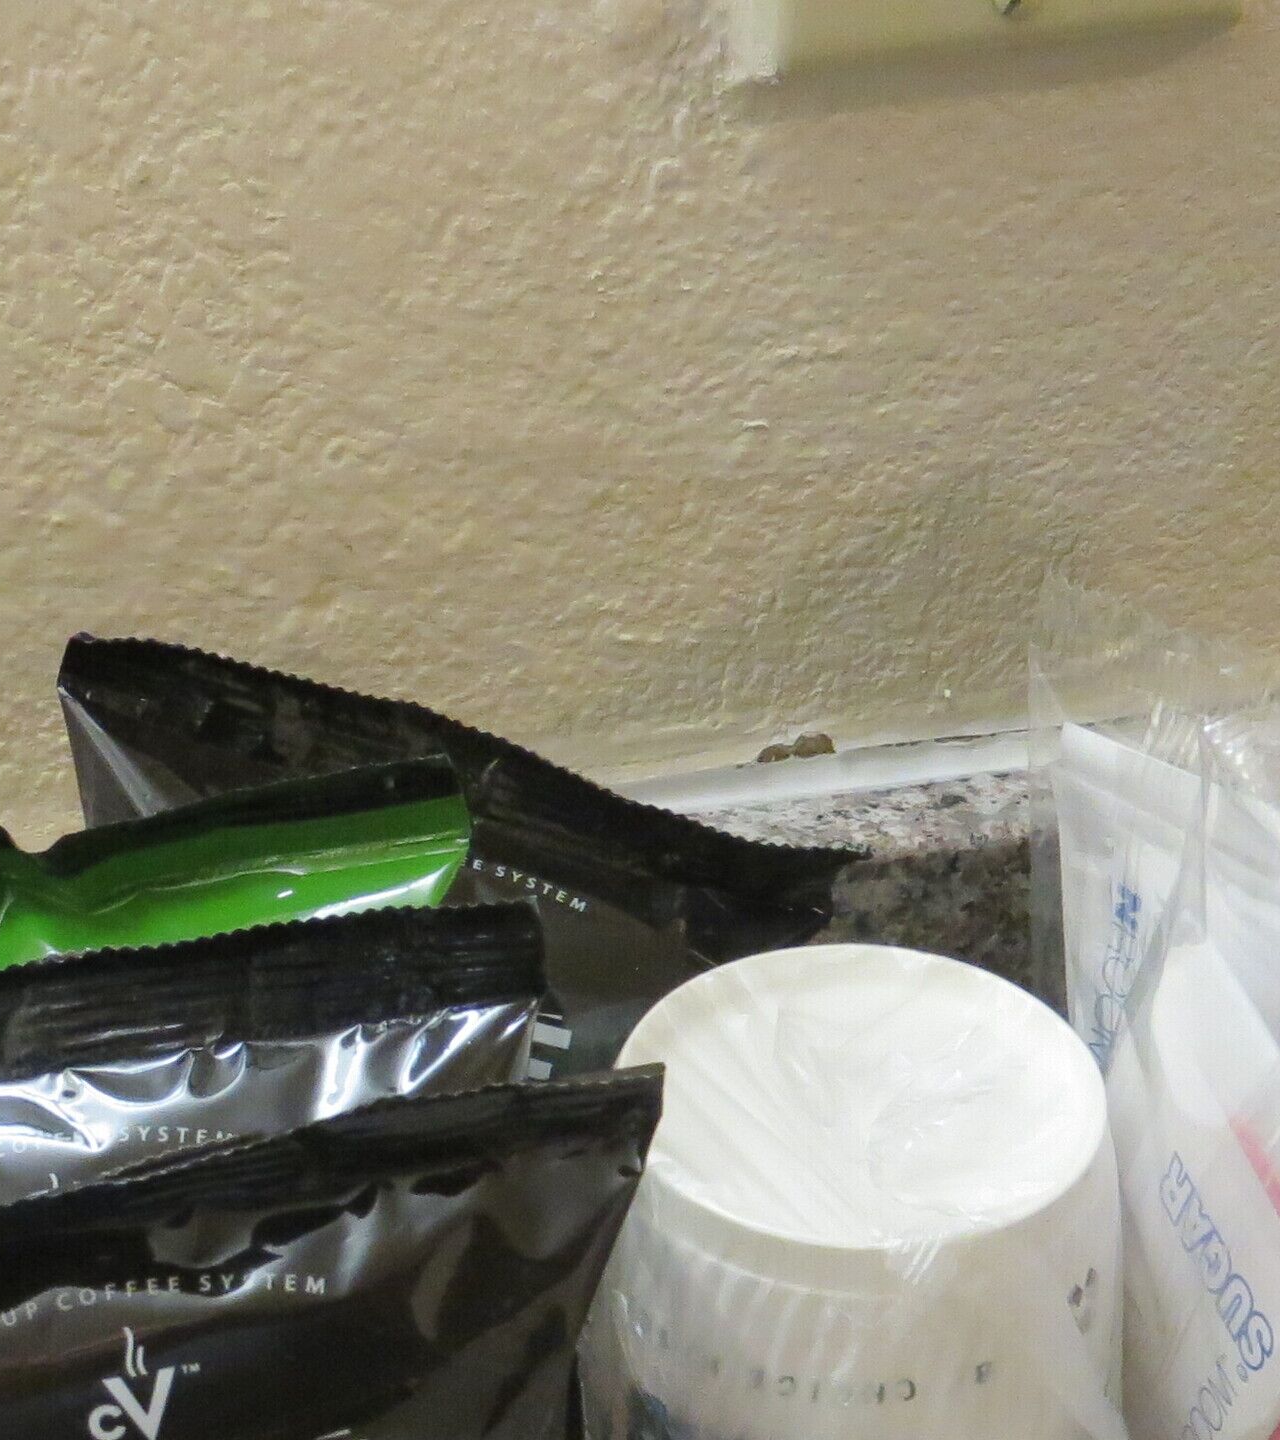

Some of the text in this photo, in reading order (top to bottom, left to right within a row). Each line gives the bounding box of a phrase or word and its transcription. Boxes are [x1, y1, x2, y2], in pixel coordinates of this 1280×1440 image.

[495, 865, 588, 913] SYSTEM
[1158, 1150, 1275, 1372] SUGAR
[56, 1275, 182, 1311] COFFEE
